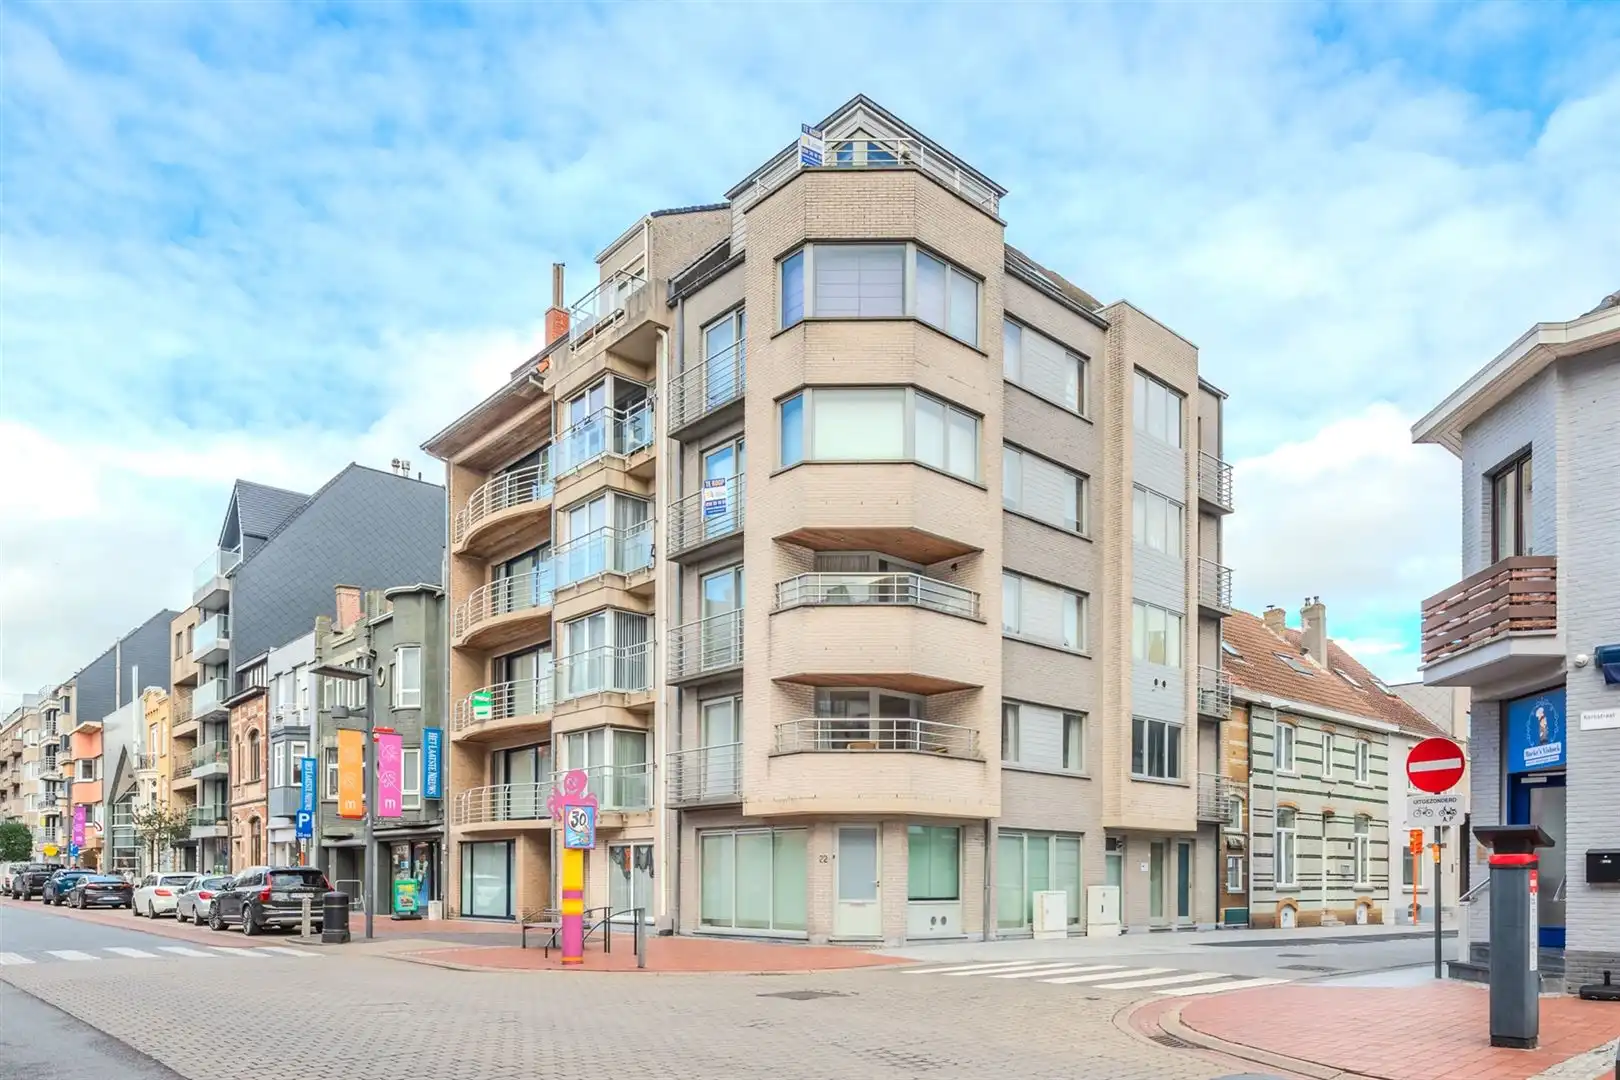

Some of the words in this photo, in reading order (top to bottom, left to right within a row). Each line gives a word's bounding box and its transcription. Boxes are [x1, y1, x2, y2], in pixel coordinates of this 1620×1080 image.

[428, 732, 438, 745] HET
[1413, 797, 1457, 805] UITGEZONDERD
[299, 813, 310, 828] P
[570, 811, 587, 828] 30
[819, 854, 828, 864] 22
